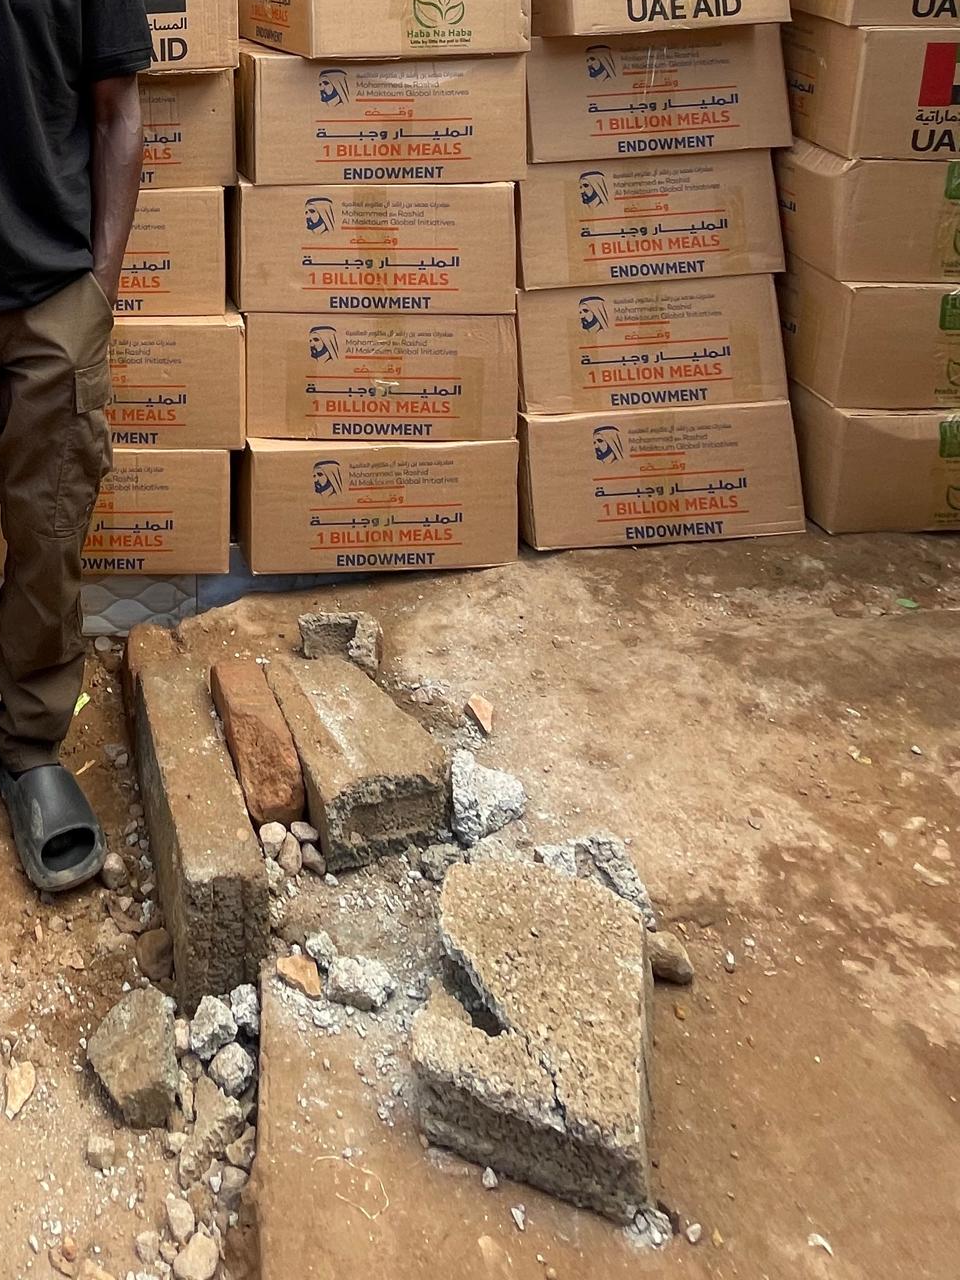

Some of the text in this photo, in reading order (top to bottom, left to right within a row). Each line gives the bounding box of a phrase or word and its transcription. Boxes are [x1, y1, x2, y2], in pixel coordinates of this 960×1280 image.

[407, 28, 472, 38] Haba Na Haba
[596, 110, 730, 131] 1 BILLION MEALS
[323, 142, 462, 157] 1 BILLION MEALS
[617, 134, 715, 153] ENDOWMENT
[343, 166, 443, 180] ENDOWMENT
[588, 234, 720, 256] 1 BILLION MEALS
[609, 259, 706, 278] ENDOWMENT
[309, 272, 448, 285] 1 BILLION MEALS
[329, 295, 431, 309] ENDOWMENT
[588, 362, 722, 383] 1 BILLION MEALS
[610, 387, 708, 406] ENDOWMENT
[313, 399, 450, 413] 1 BILLION MEALS
[122, 408, 176, 421] MEALS
[332, 422, 432, 436] ENDOWMENT
[603, 494, 738, 516] 1 BILLION MEALS
[317, 528, 452, 544] 1 BILLION MEALS
[625, 520, 724, 539] ENDOWMENT
[109, 534, 162, 546] MEALS
[337, 551, 435, 566] ENDOWMENT
